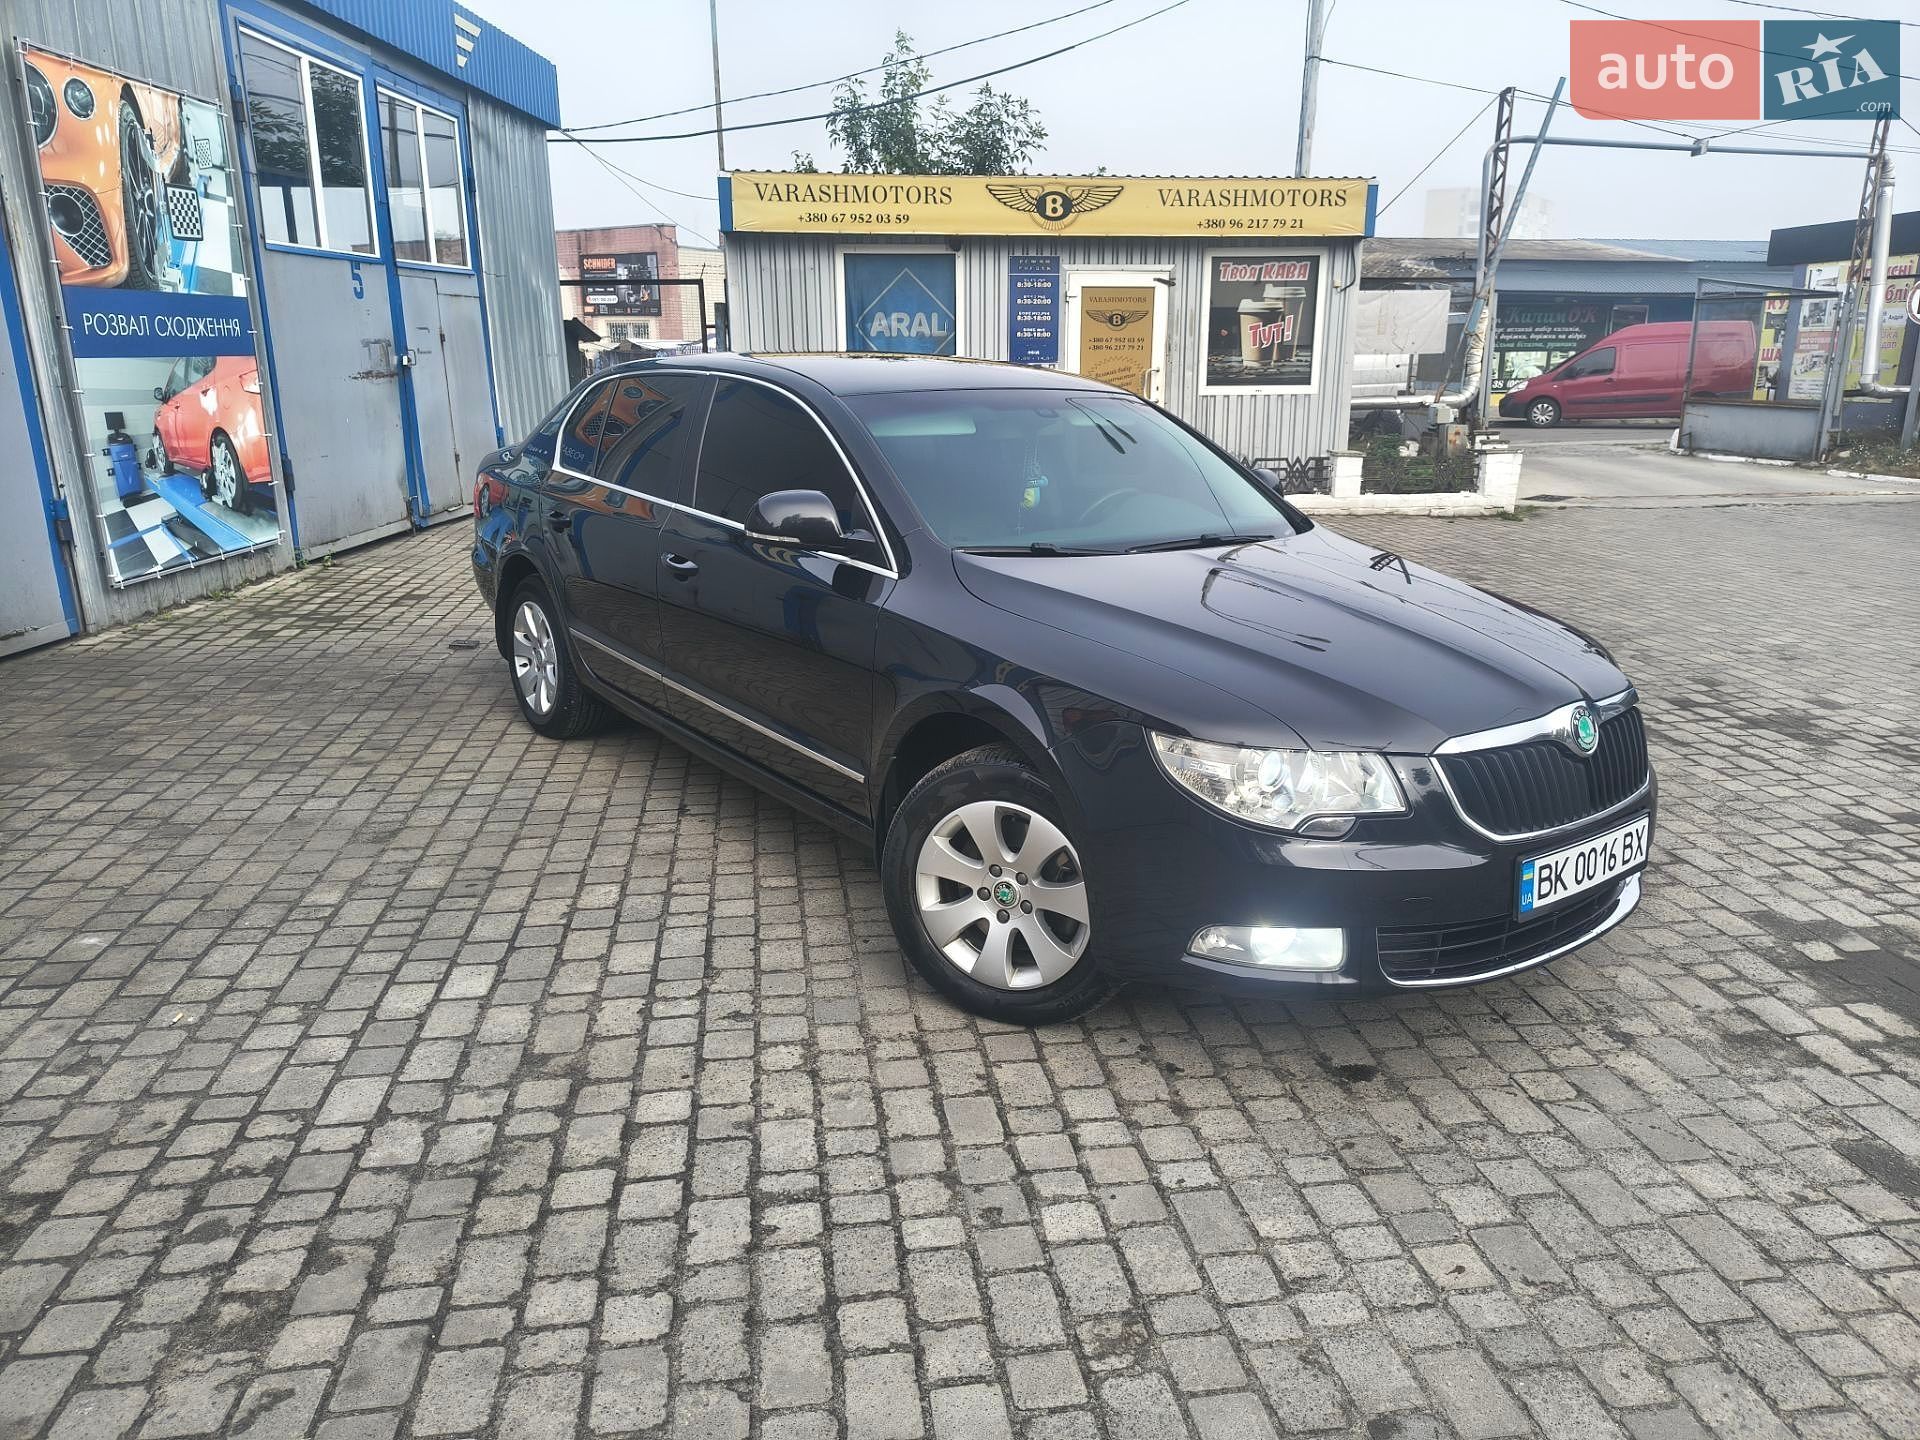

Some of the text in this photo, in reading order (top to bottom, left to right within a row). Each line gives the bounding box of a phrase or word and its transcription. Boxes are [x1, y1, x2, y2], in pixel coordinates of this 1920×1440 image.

[754, 183, 953, 206] VARASHMOTORS
[1158, 188, 1347, 208] VARASHMOTORS
[798, 211, 910, 225] +380 67 952 03 59
[1197, 218, 1304, 229] +380 96 217 79 21
[350, 260, 365, 299] 5
[1220, 261, 1310, 281] Твоя КАВА
[1089, 296, 1147, 304] VARASHMOTORS
[82, 313, 241, 341] РОЗВАЛ СХОДЖЕННЯ
[870, 311, 948, 338] ARAL
[1248, 315, 1294, 349] Тут!
[1537, 824, 1646, 900] BK 0016 BX
[1521, 891, 1533, 906] UA
